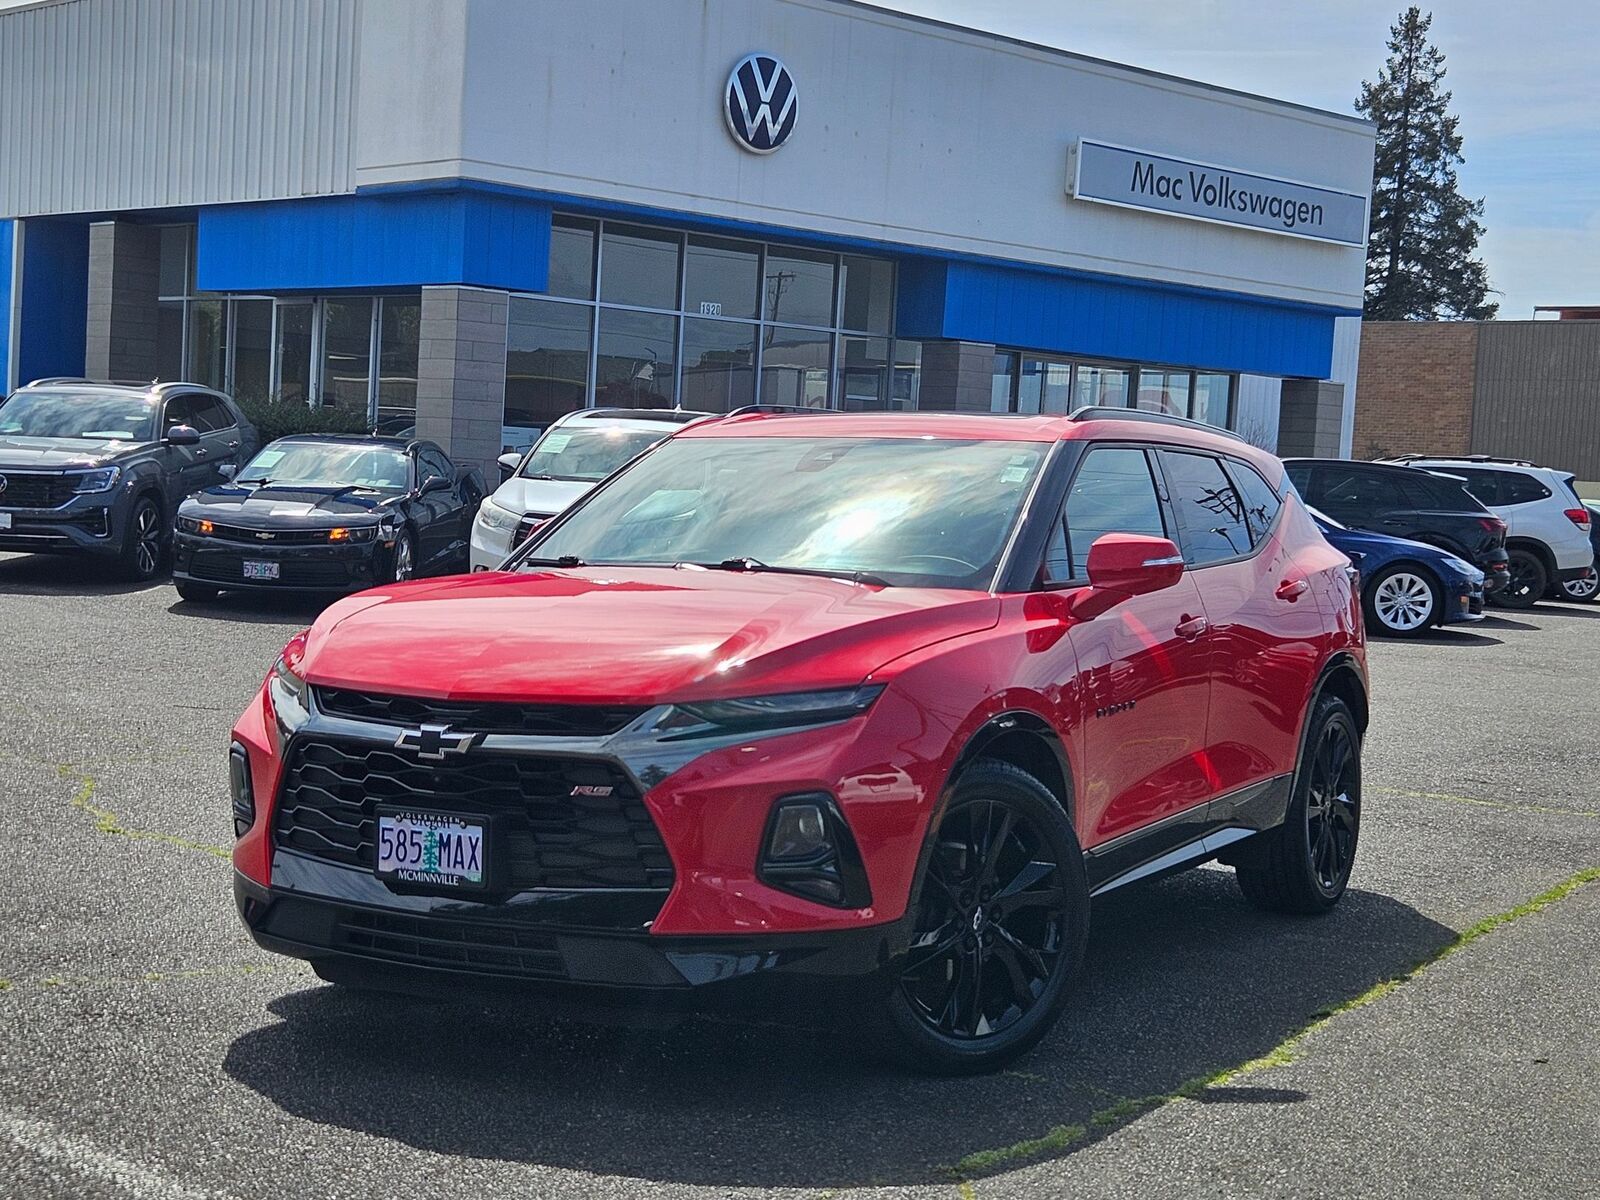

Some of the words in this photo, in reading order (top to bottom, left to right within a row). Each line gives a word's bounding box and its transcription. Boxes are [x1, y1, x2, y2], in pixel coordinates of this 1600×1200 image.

[1130, 160, 1183, 201] Mac
[1188, 170, 1323, 229] Volkswagen
[702, 303, 721, 316] 1920
[400, 811, 461, 824] VOLKSWAGEN
[381, 827, 422, 863] 585
[438, 833, 480, 871] MAX
[398, 869, 459, 886] MCMINNVILLE
